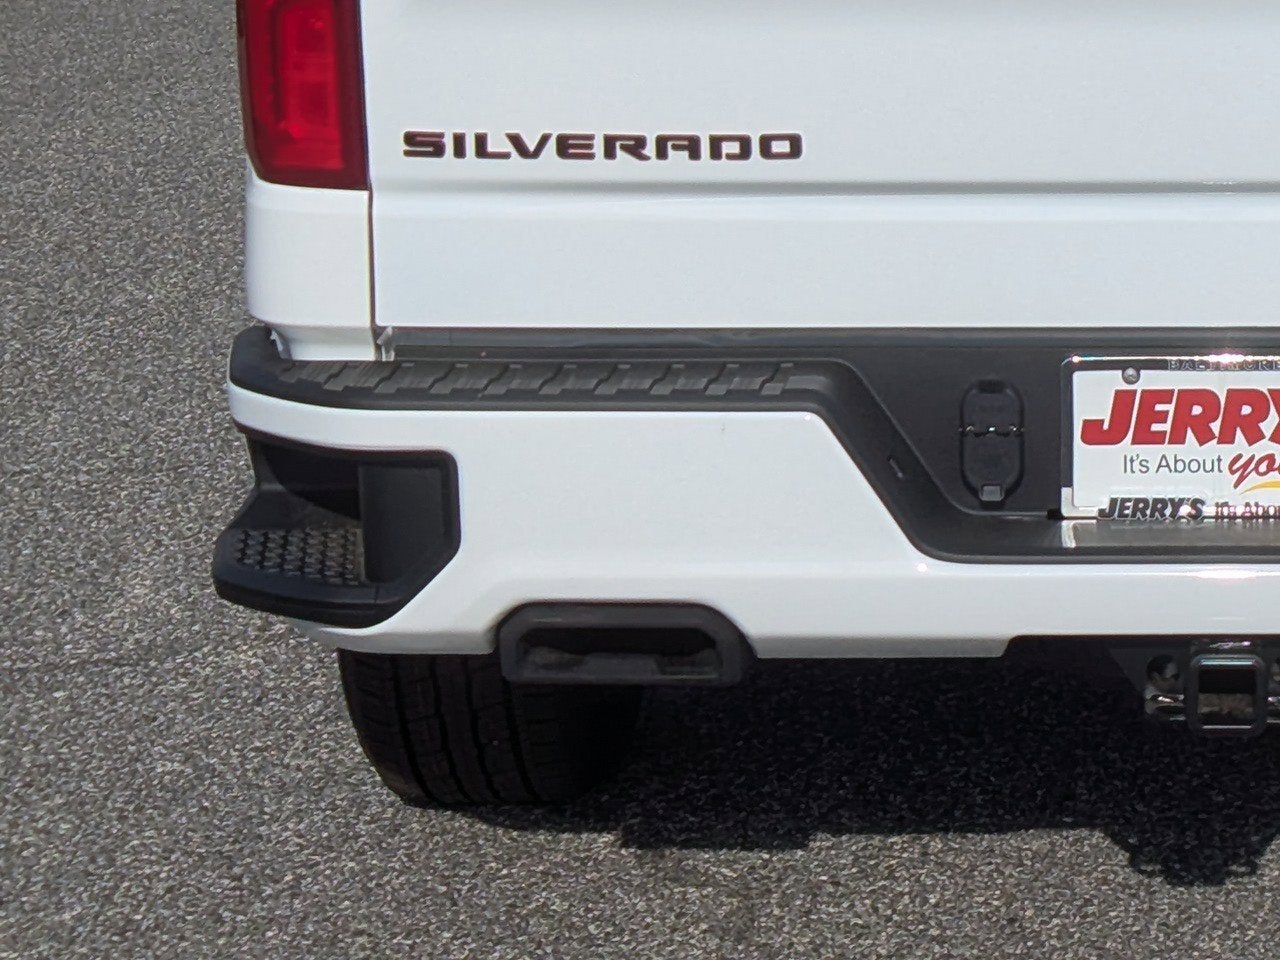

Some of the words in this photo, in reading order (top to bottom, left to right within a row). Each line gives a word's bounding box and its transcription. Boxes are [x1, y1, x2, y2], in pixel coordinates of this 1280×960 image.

[404, 132, 802, 160] SILVERADO
[1123, 454, 1150, 474] It's
[1155, 454, 1223, 474] About
[1098, 496, 1206, 520] JERRY'S
